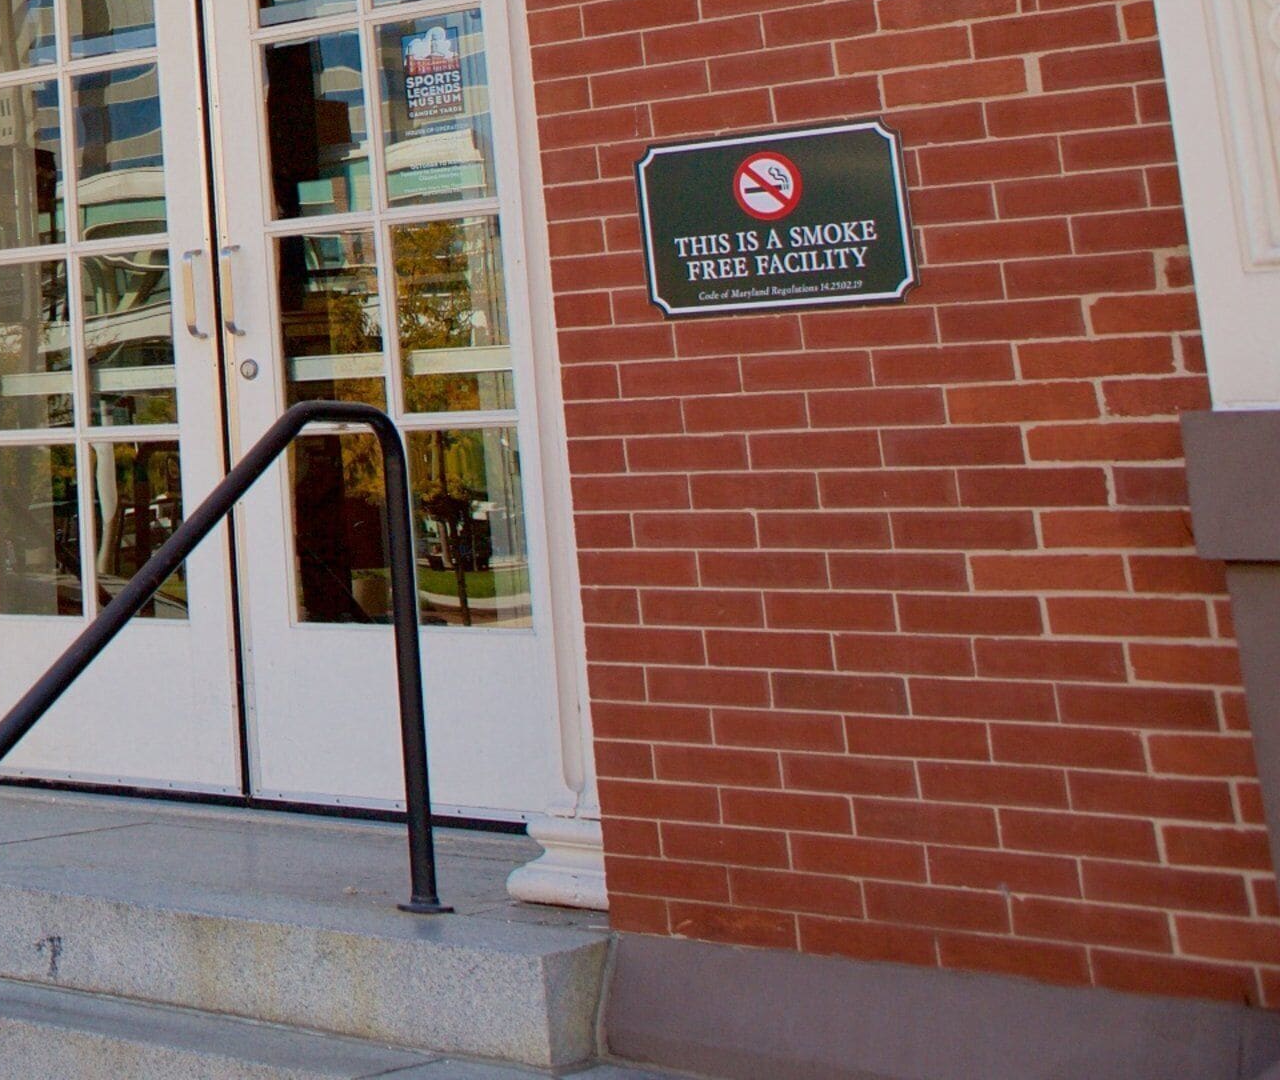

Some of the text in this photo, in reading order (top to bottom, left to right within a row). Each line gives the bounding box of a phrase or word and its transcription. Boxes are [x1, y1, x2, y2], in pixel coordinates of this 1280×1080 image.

[406, 71, 460, 88] SPORTS
[407, 82, 461, 98] LEGENDS
[408, 93, 461, 108] MUSEUM
[674, 220, 877, 257] THIS IS A SMOKE
[686, 247, 868, 281] FREE FACILITY
[698, 291, 719, 301] Code
[720, 290, 729, 299] of
[731, 286, 770, 299] Maryland
[771, 282, 819, 297] Regulations
